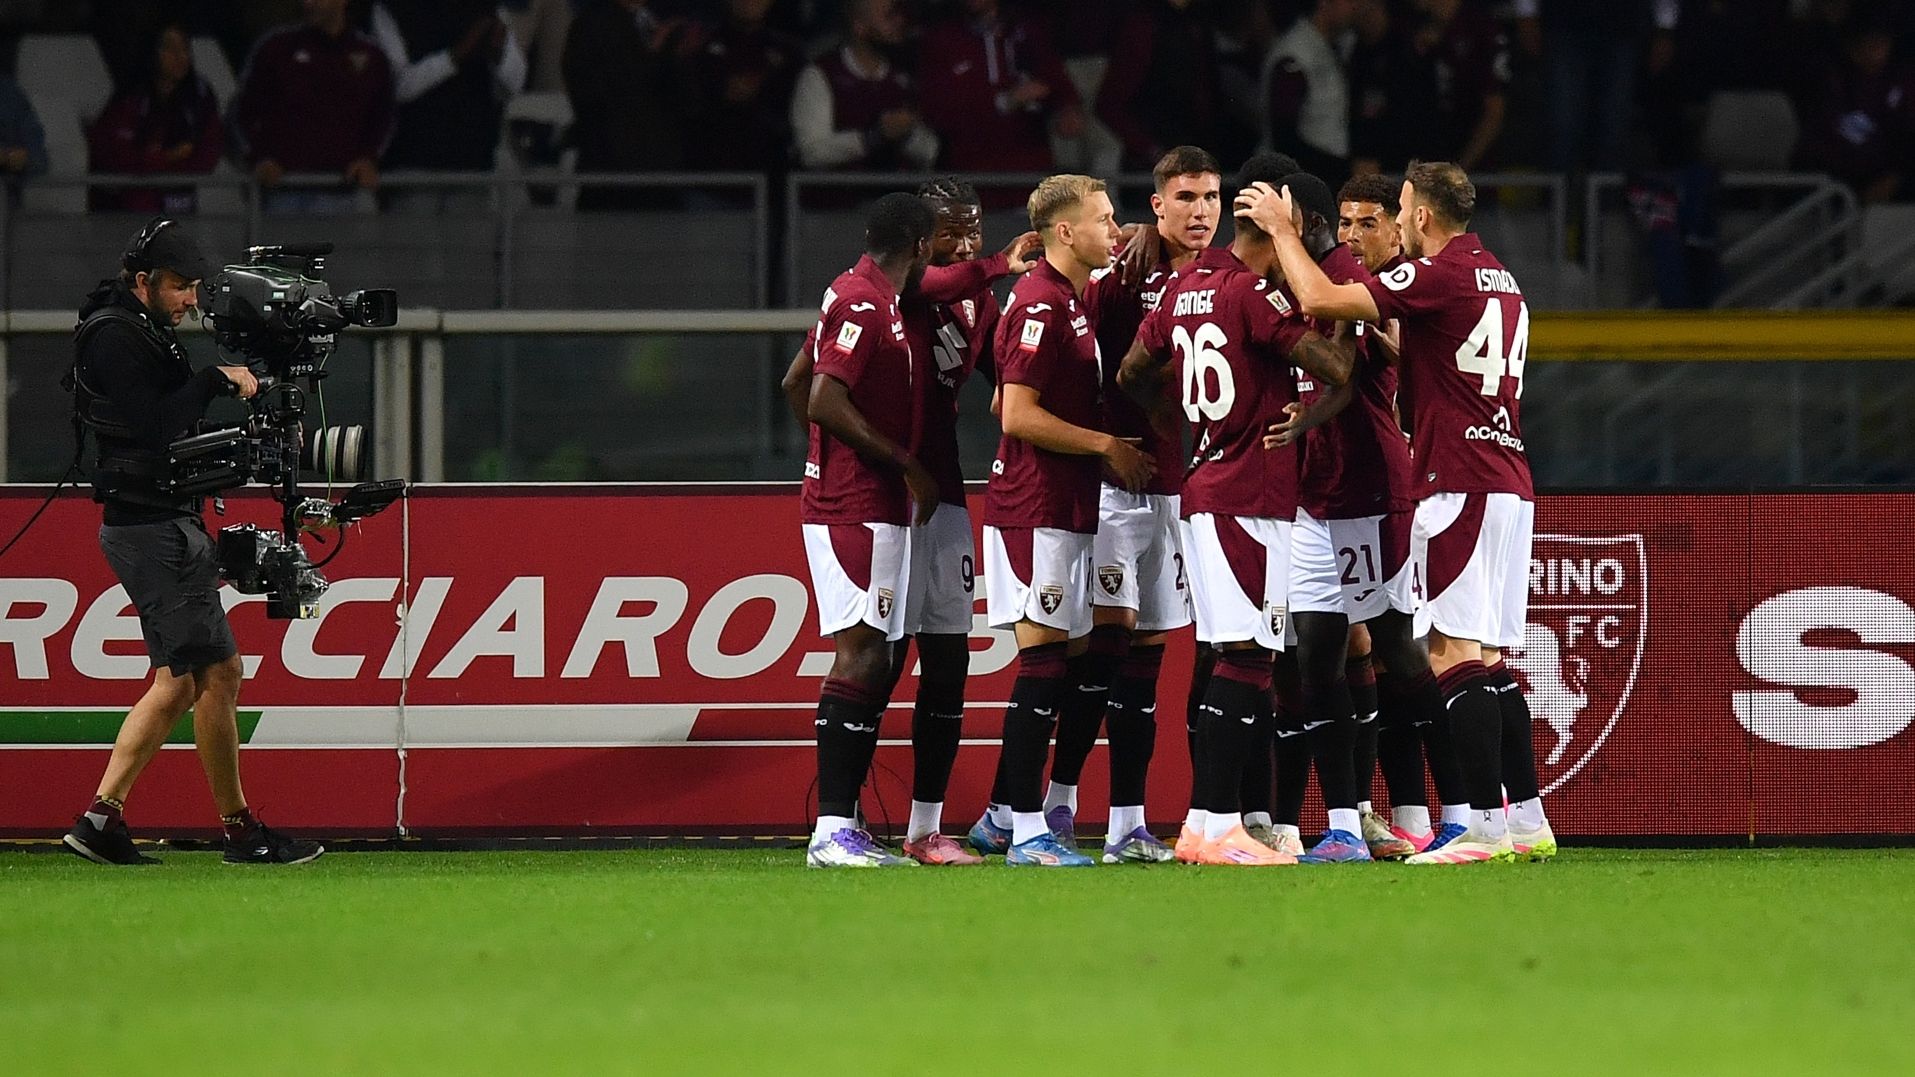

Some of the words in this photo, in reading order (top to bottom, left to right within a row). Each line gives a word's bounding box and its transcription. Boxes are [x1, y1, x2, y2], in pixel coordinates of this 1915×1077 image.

[1171, 321, 1236, 423] 26
[1456, 297, 1530, 400] 44
[961, 554, 974, 593] 9
[1338, 544, 1377, 586] 21
[1565, 616, 1620, 648] FC
[1731, 585, 1915, 750] S
